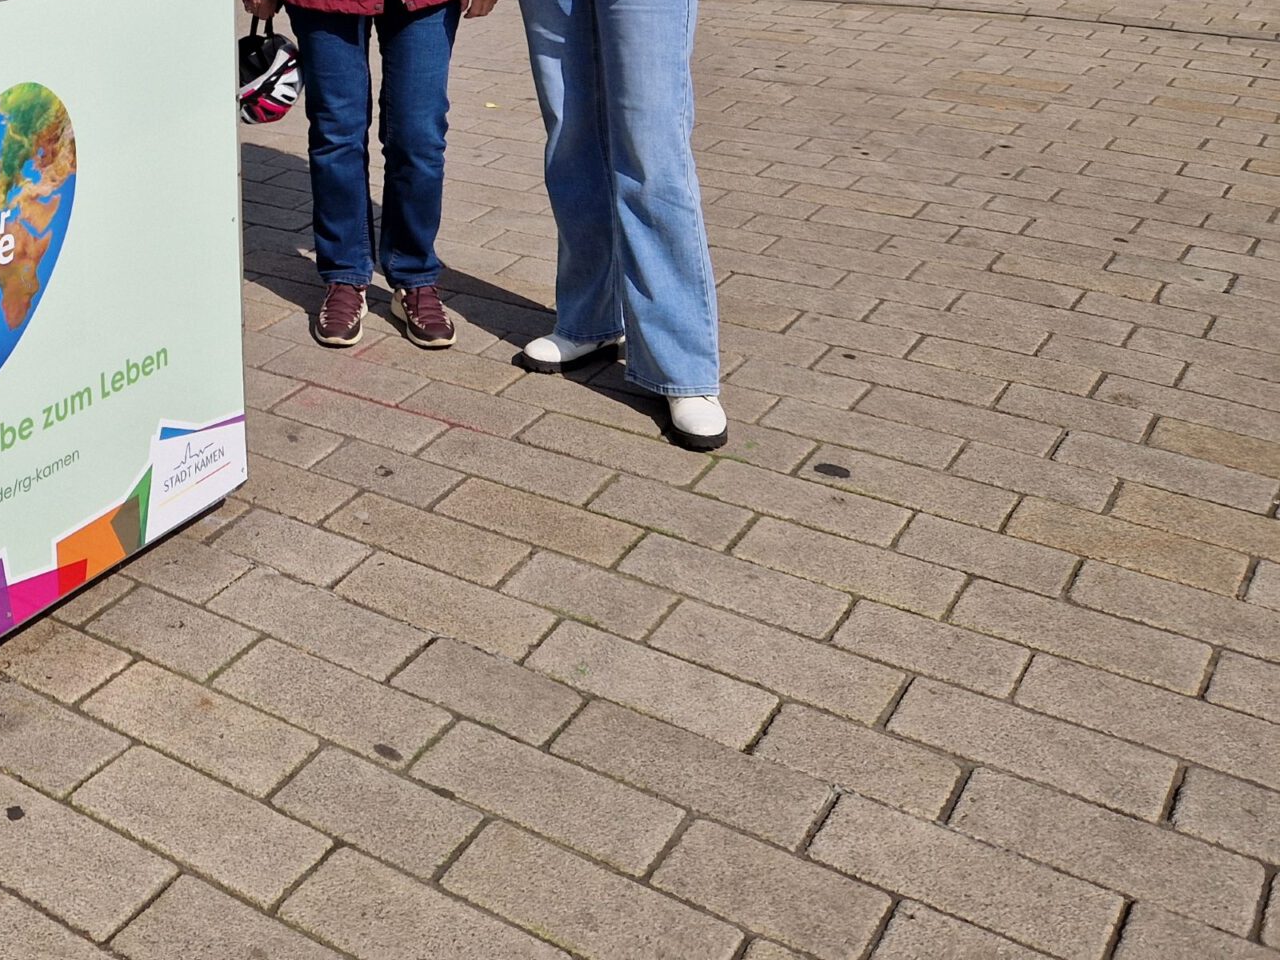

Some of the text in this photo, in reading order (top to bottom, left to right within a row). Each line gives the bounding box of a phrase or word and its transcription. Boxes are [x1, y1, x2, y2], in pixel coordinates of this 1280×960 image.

[42, 386, 92, 431] zum
[101, 347, 169, 400] Leben
[163, 446, 224, 493] STADT KAMEN
